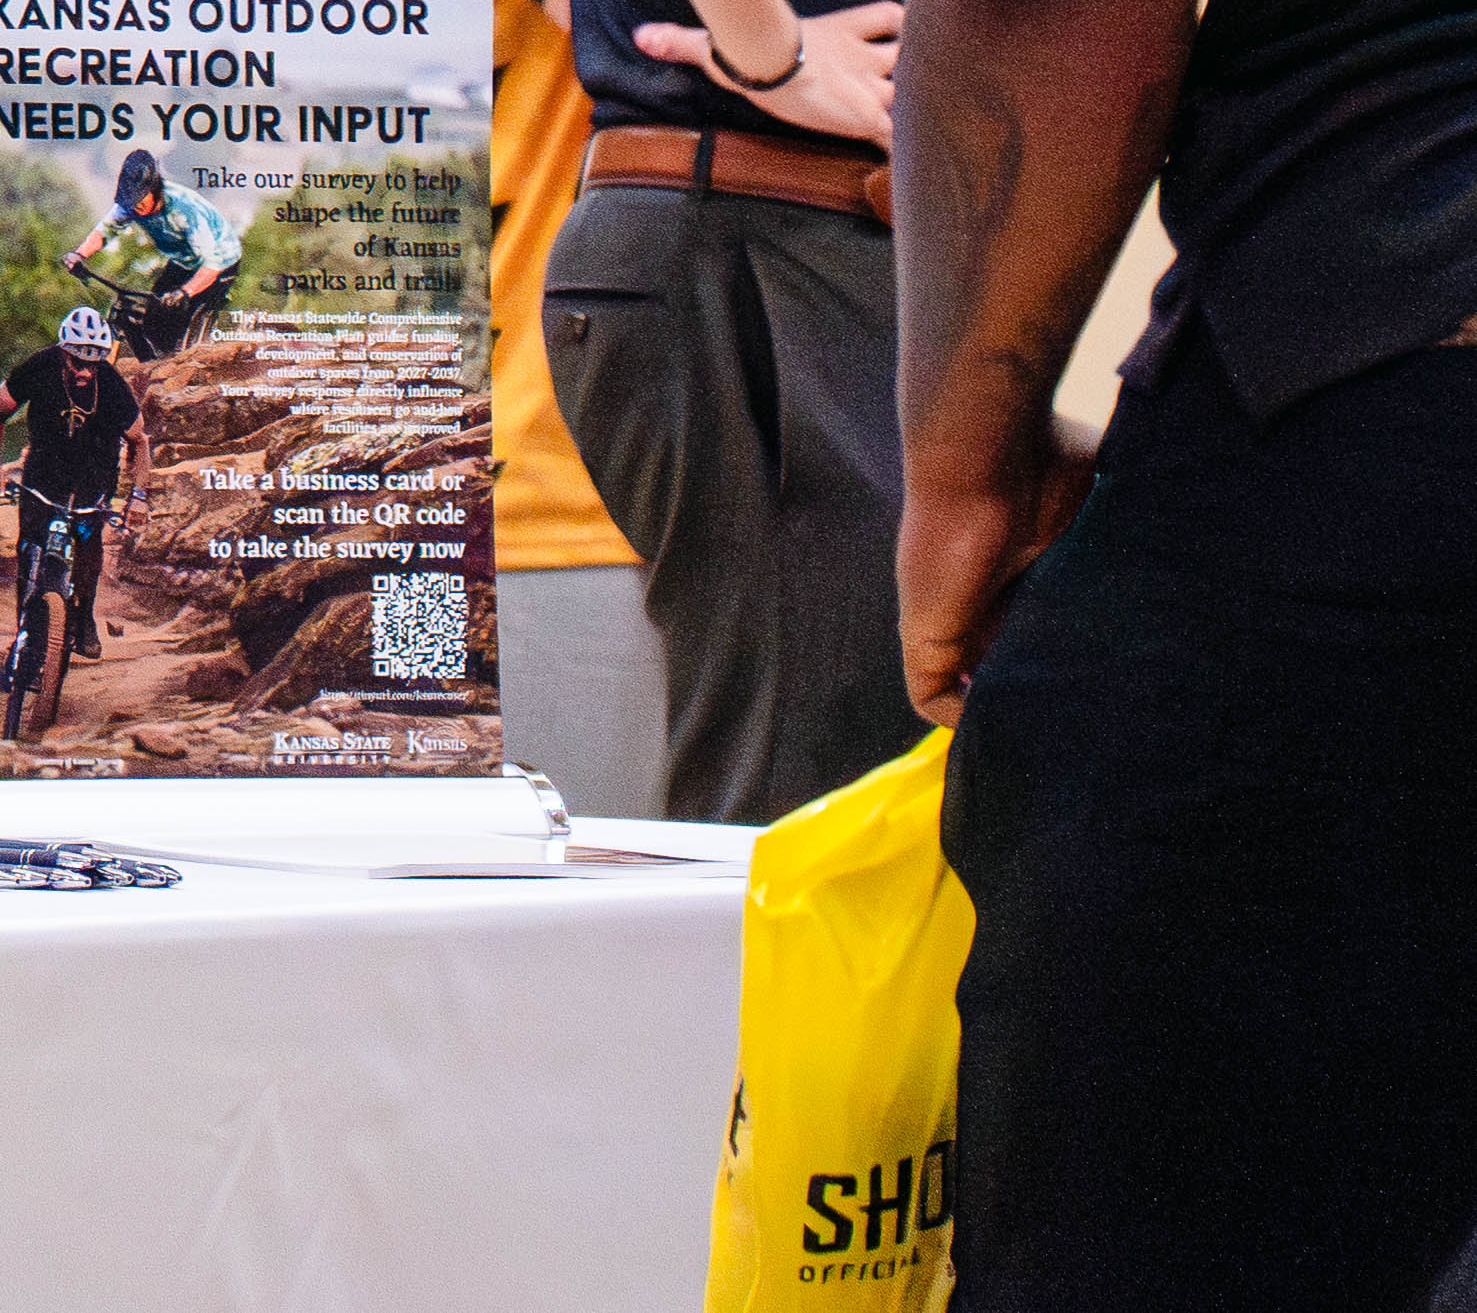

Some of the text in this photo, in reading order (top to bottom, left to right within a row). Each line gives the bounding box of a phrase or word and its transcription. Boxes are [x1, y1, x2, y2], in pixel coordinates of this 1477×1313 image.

[152, 104, 280, 143] YOUR
[299, 106, 430, 144] INPUT
[192, 167, 462, 195] Take our survey to help
[273, 201, 462, 227] shape the future
[353, 234, 462, 259] of Kansas
[284, 269, 348, 292] parks
[354, 269, 396, 292] and
[230, 311, 463, 327] The Kansas Statewide Comprehensive
[199, 468, 466, 492] Take a business card or
[273, 501, 467, 528] scan the QR code
[208, 534, 467, 564] to take the survey now
